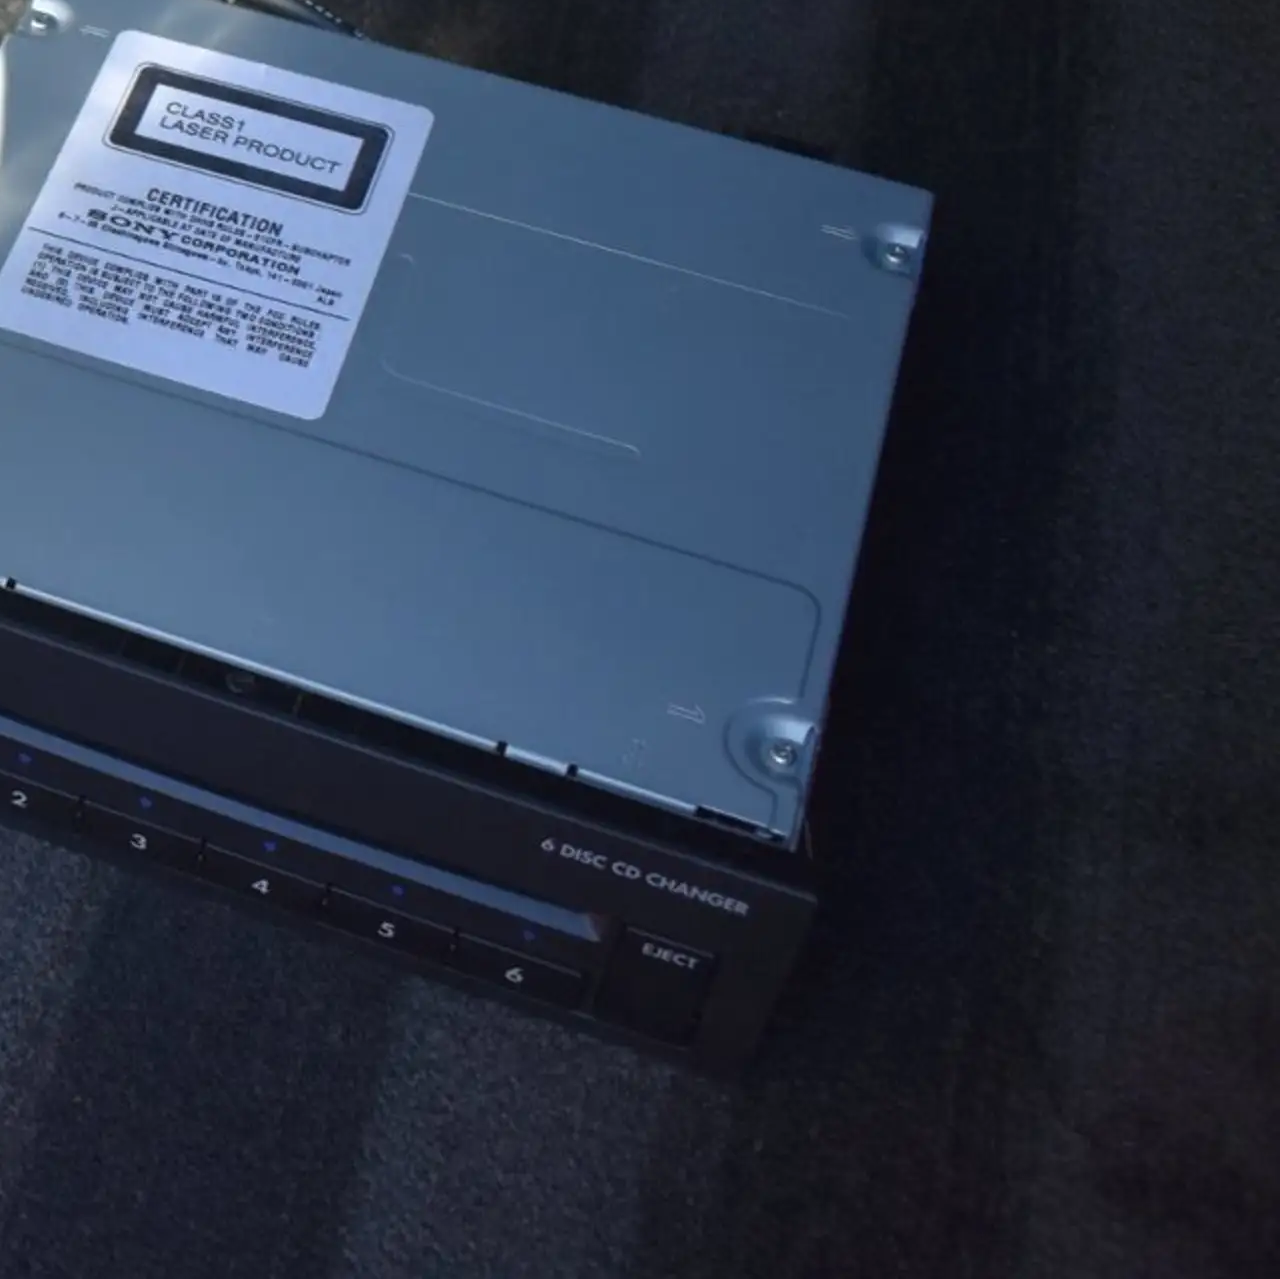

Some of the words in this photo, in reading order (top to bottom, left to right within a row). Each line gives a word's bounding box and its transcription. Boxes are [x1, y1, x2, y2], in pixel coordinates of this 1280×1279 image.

[158, 114, 229, 145] LASER
[232, 134, 341, 175] PRODUCT
[145, 187, 284, 237] CERTIFICATION
[87, 208, 181, 241] SONY
[180, 235, 301, 276] CORPORATION
[12, 790, 27, 807] 2
[131, 833, 147, 850] 3
[252, 879, 269, 894] 4
[540, 838, 555, 851] 6
[559, 843, 607, 869] DISC
[611, 861, 641, 879] CD
[645, 872, 749, 916] CHANGER
[377, 921, 395, 938] 5
[642, 942, 697, 969] EJECT
[505, 967, 523, 983] 6
